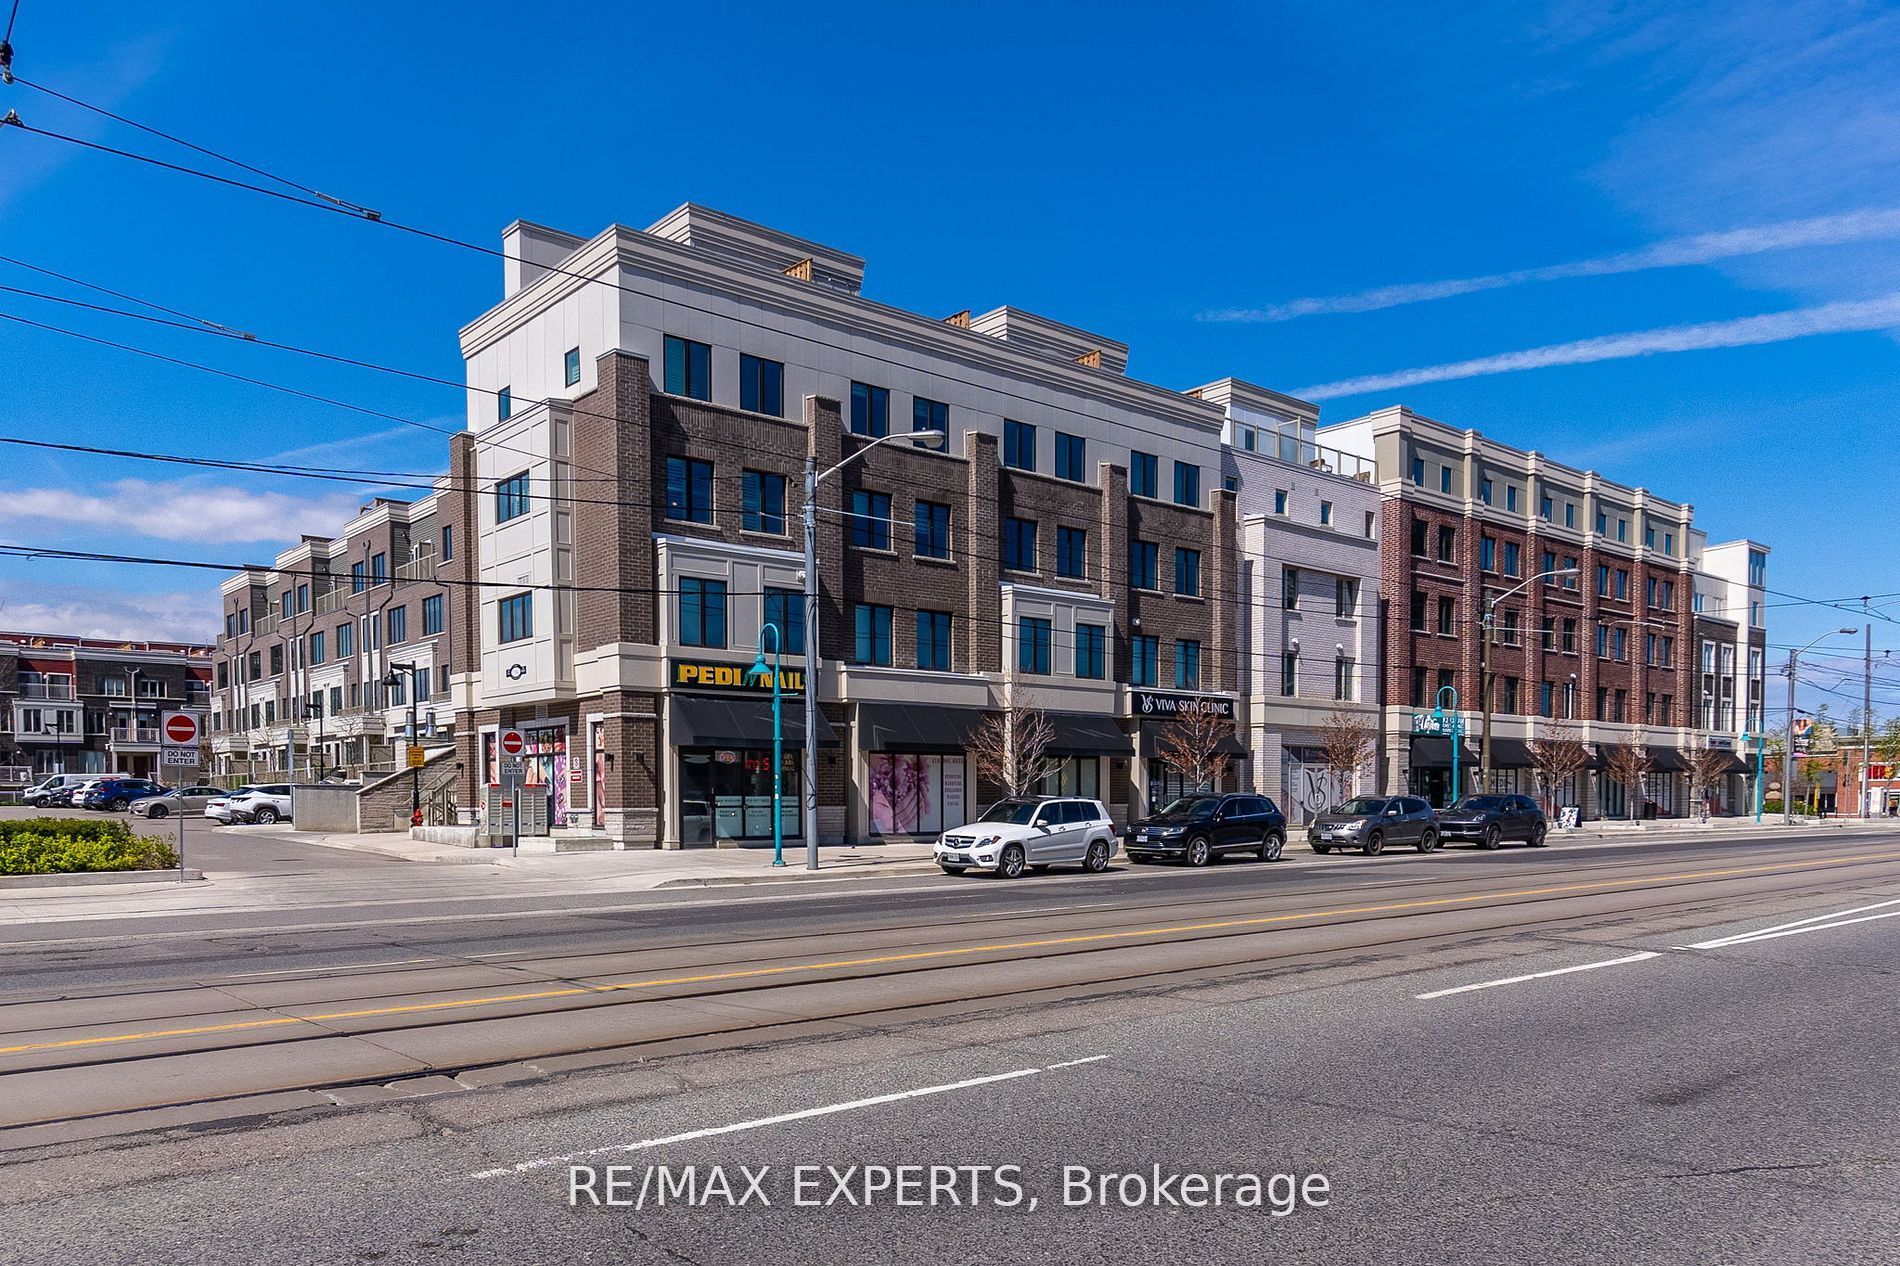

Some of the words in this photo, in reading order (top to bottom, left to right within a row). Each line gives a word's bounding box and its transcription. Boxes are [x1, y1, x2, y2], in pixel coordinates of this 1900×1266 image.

[677, 664, 742, 686] PEDI
[759, 671, 806, 689] NAIL
[1155, 698, 1177, 712] VIVA
[1178, 700, 1199, 714] SKIN
[1200, 701, 1230, 715] CLINIC
